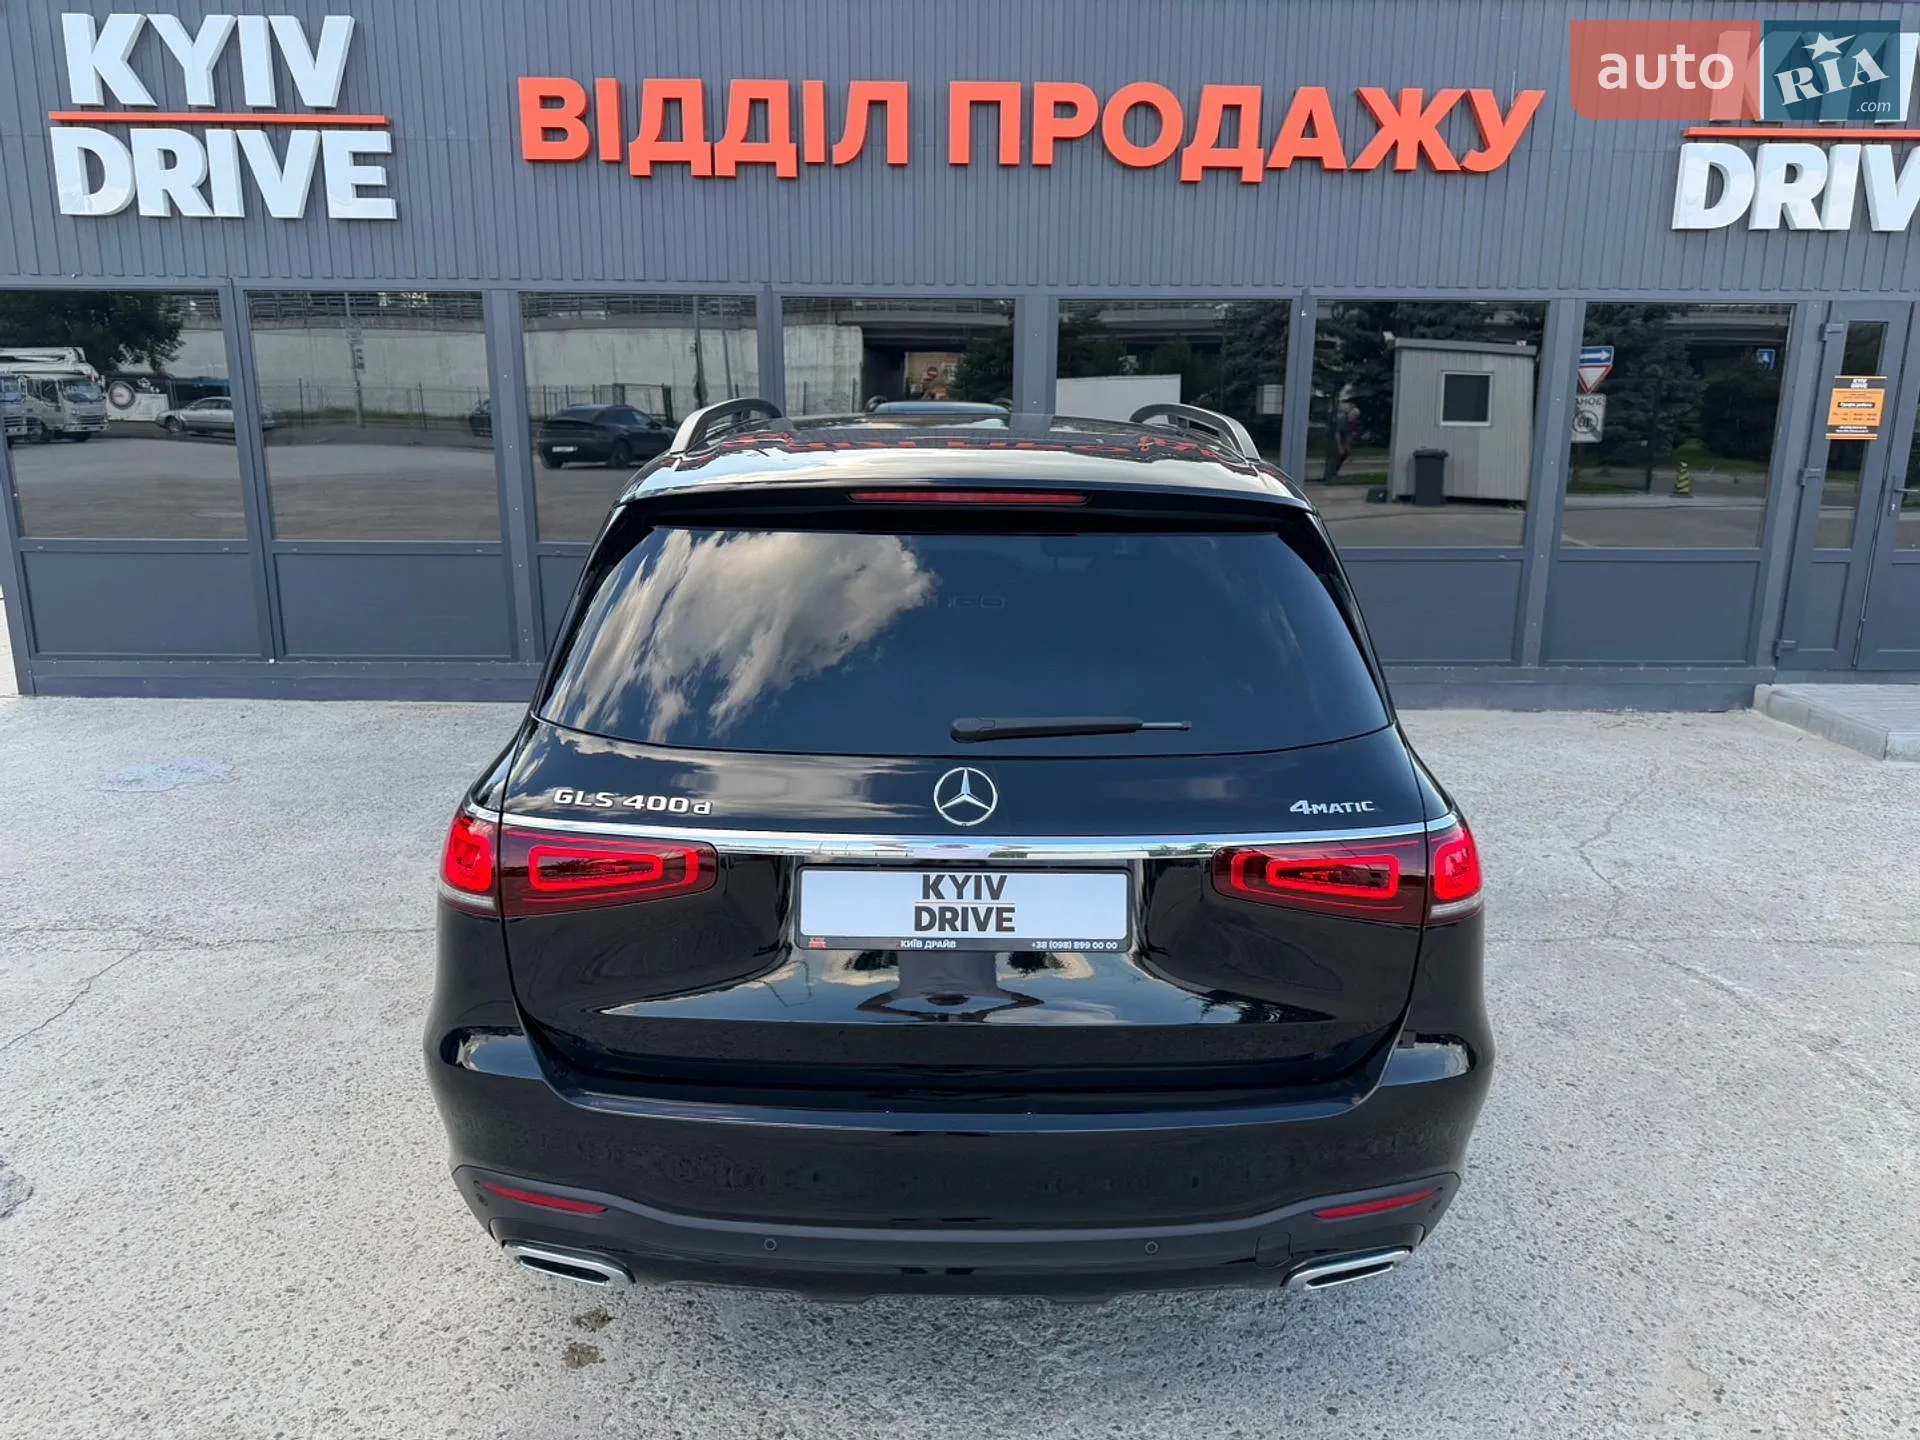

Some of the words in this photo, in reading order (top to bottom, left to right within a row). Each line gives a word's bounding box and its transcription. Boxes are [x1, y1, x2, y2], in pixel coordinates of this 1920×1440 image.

[61, 13, 355, 107] KYIV
[517, 77, 908, 178] ВІДДІЛ
[949, 81, 1546, 183] ПРОДАЖУ
[50, 127, 397, 219] DRIVE
[553, 788, 616, 808] GLS
[622, 794, 712, 815] 400d
[1289, 799, 1376, 815] 4MATIC
[922, 874, 1008, 900] KYIV
[914, 905, 1016, 932] DRIVE
[900, 939, 923, 949] КИЇВ
[924, 939, 957, 949] ДРАЙВ
[1049, 940, 1072, 950] (098)
[1092, 941, 1104, 949] 00
[1105, 941, 1118, 949] 00
